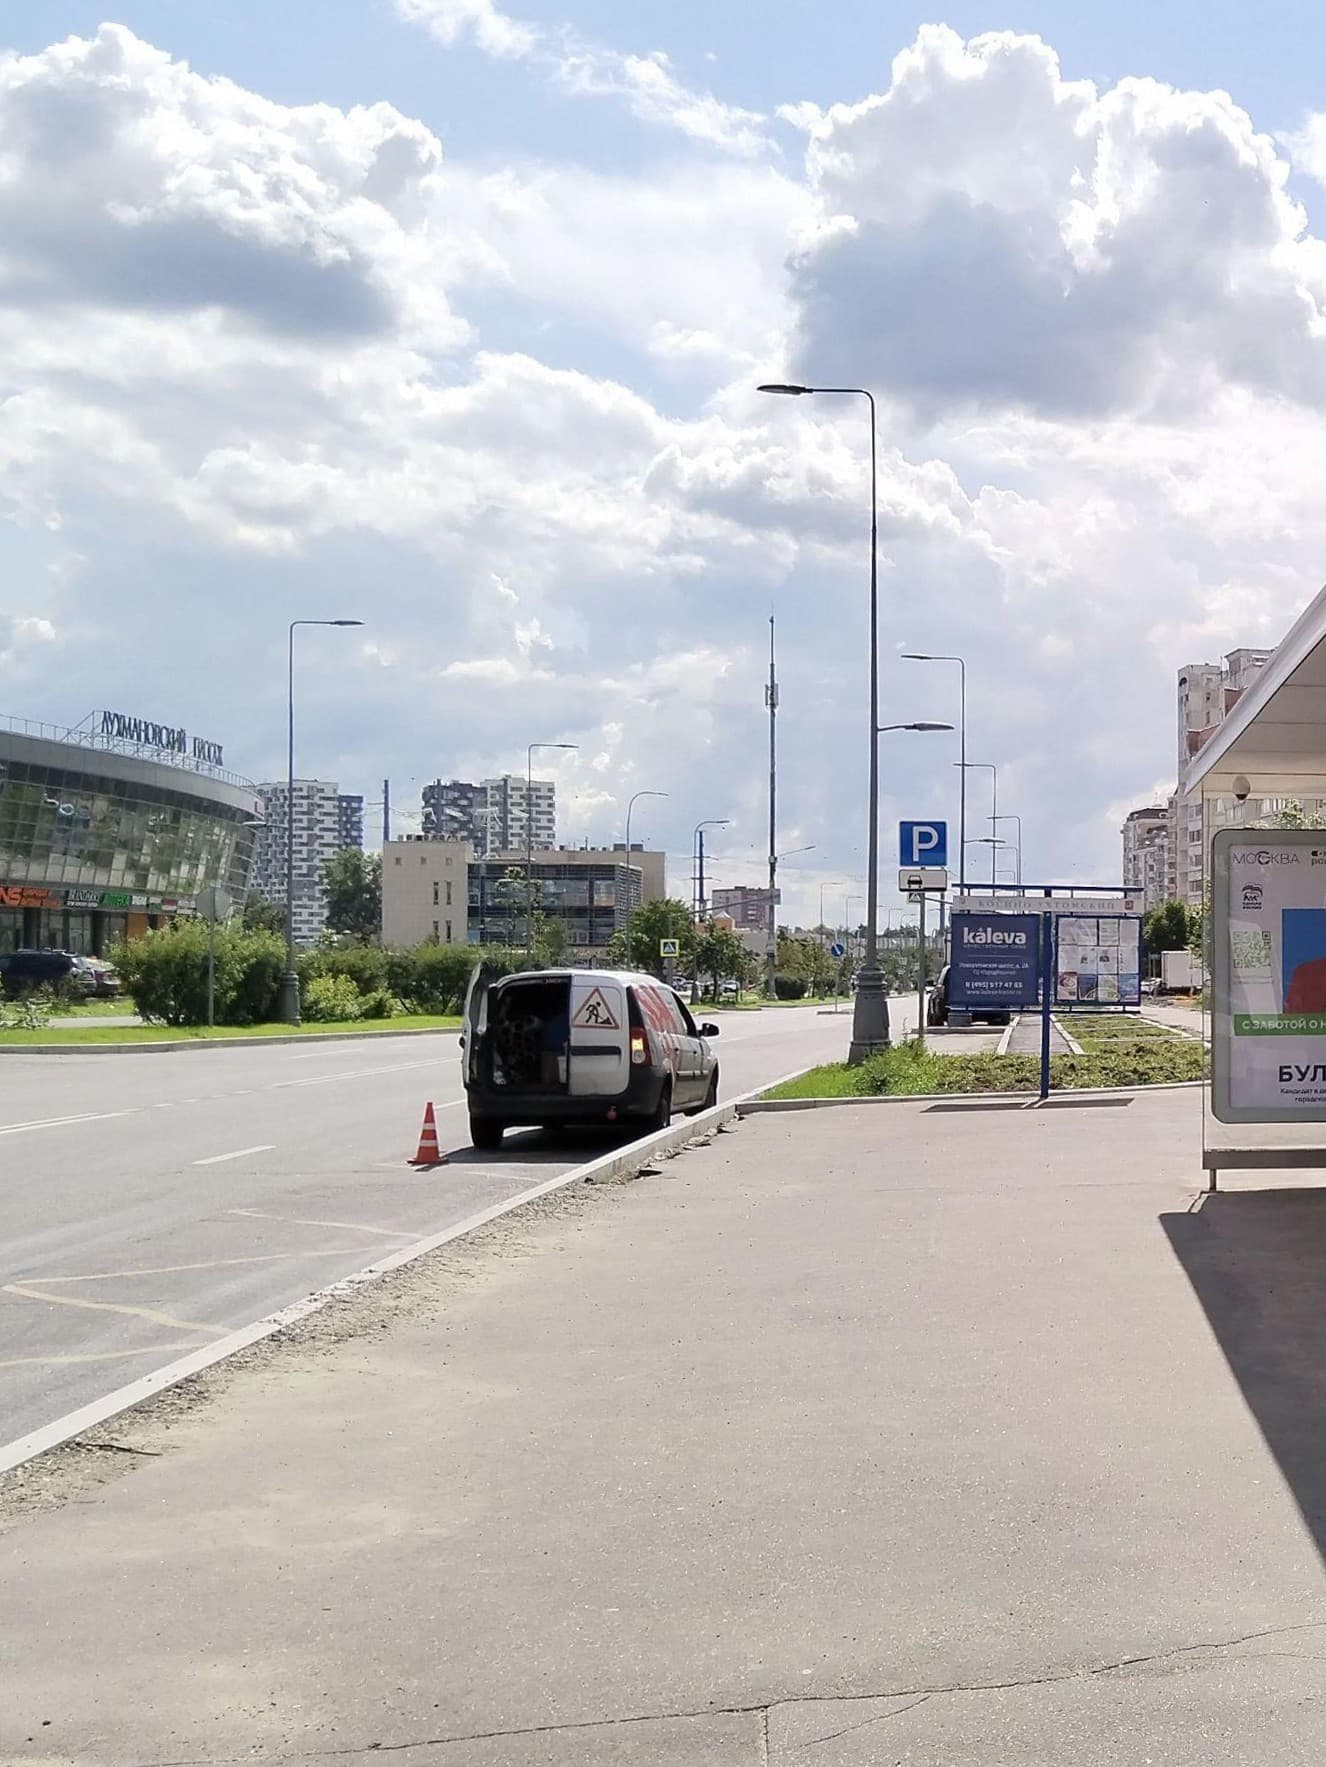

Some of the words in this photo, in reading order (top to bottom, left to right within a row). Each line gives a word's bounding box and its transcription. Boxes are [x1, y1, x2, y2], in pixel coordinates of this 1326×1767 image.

[1233, 850, 1300, 866] МОСКВА
[1241, 1020, 1250, 1030] С
[1253, 1018, 1307, 1030] ЗАБОТОЙ
[1309, 1019, 1318, 1029] О
